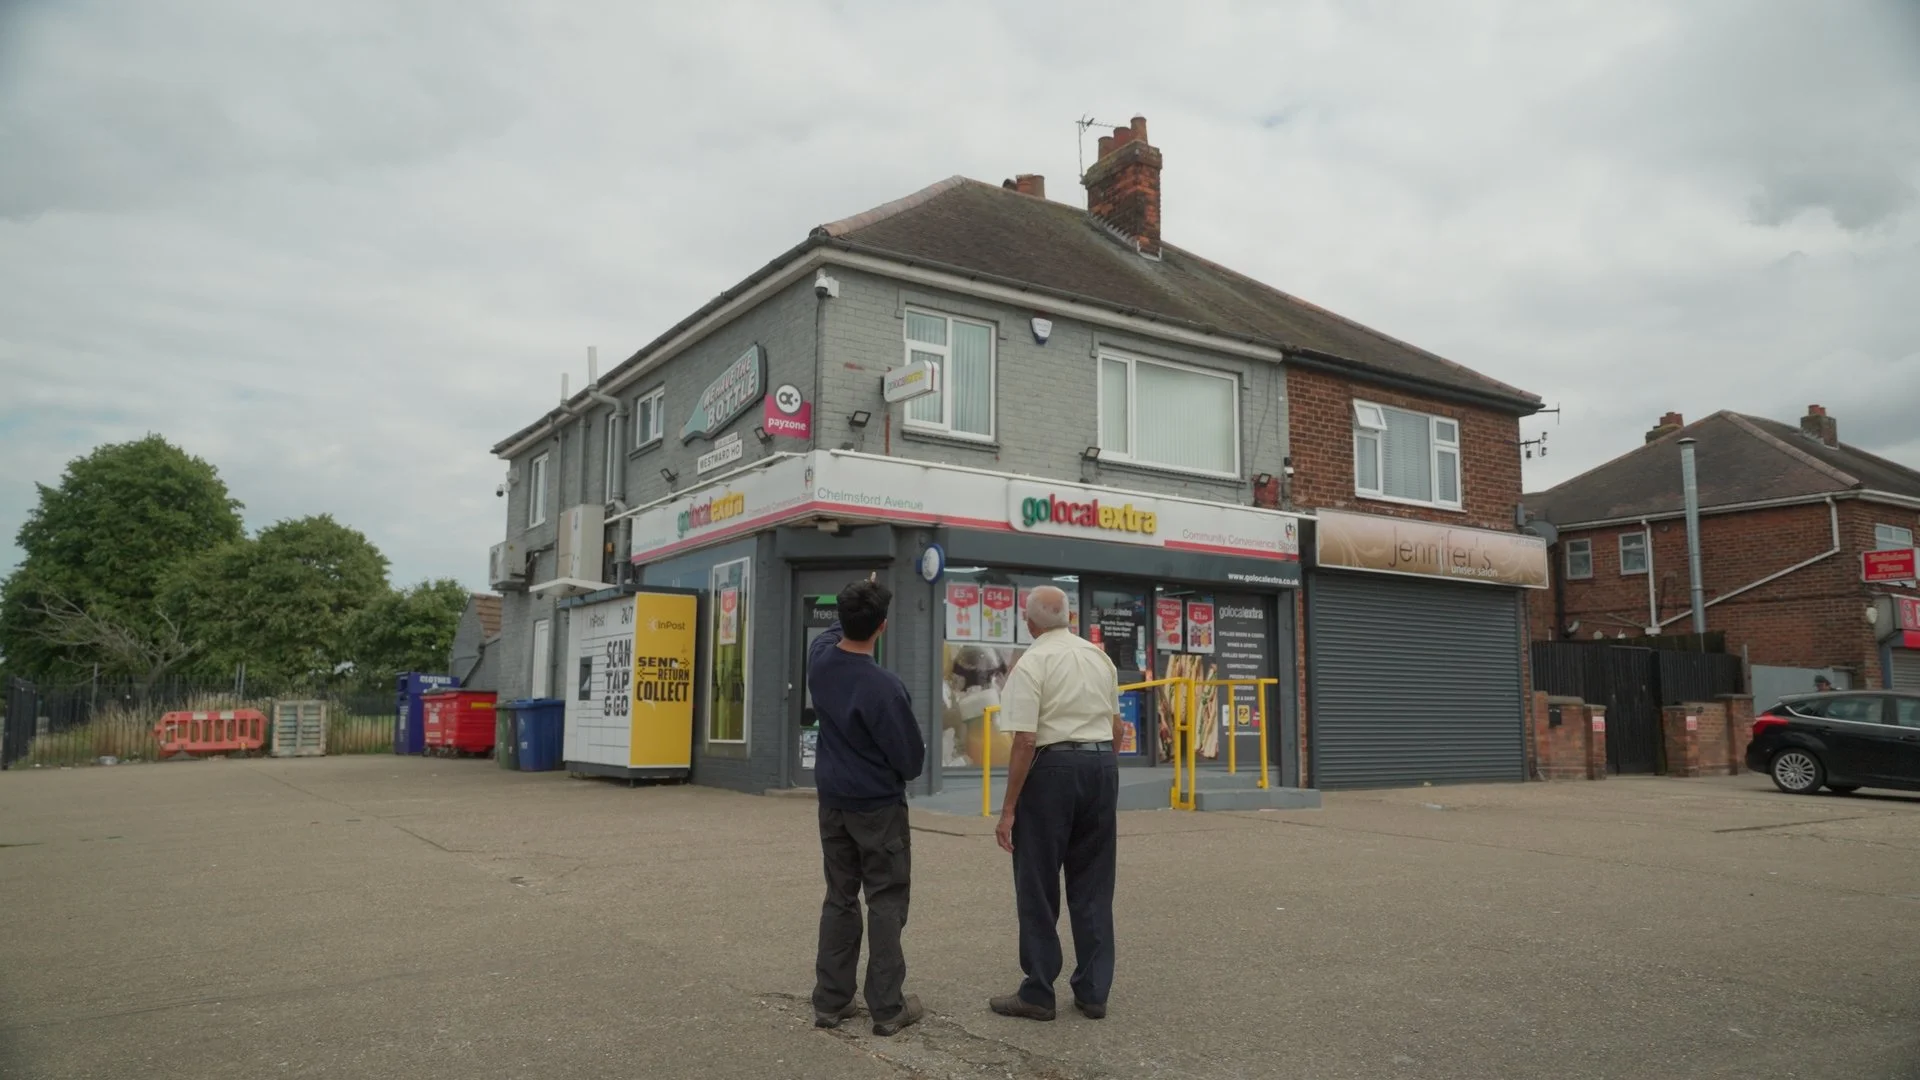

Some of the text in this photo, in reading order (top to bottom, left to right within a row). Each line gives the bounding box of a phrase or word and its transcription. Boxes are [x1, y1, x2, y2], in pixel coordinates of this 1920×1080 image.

[715, 370, 735, 399] HAVE
[735, 354, 753, 380] THE
[706, 371, 756, 430] BOTTLE
[768, 417, 807, 432] payzone
[817, 486, 882, 506] Chelmsford
[883, 495, 924, 511] Avenue
[1022, 493, 1157, 535] golocalextra
[1182, 529, 1297, 552] Community Convenience Store
[1451, 566, 1498, 578] unisex salon
[1219, 605, 1263, 619] golocalextra
[657, 620, 686, 631] InPost
[606, 639, 632, 669] SCAN
[638, 657, 678, 667] SEND
[605, 671, 630, 693] TAP
[658, 669, 689, 681] RETURN
[636, 680, 689, 702] COLLECT
